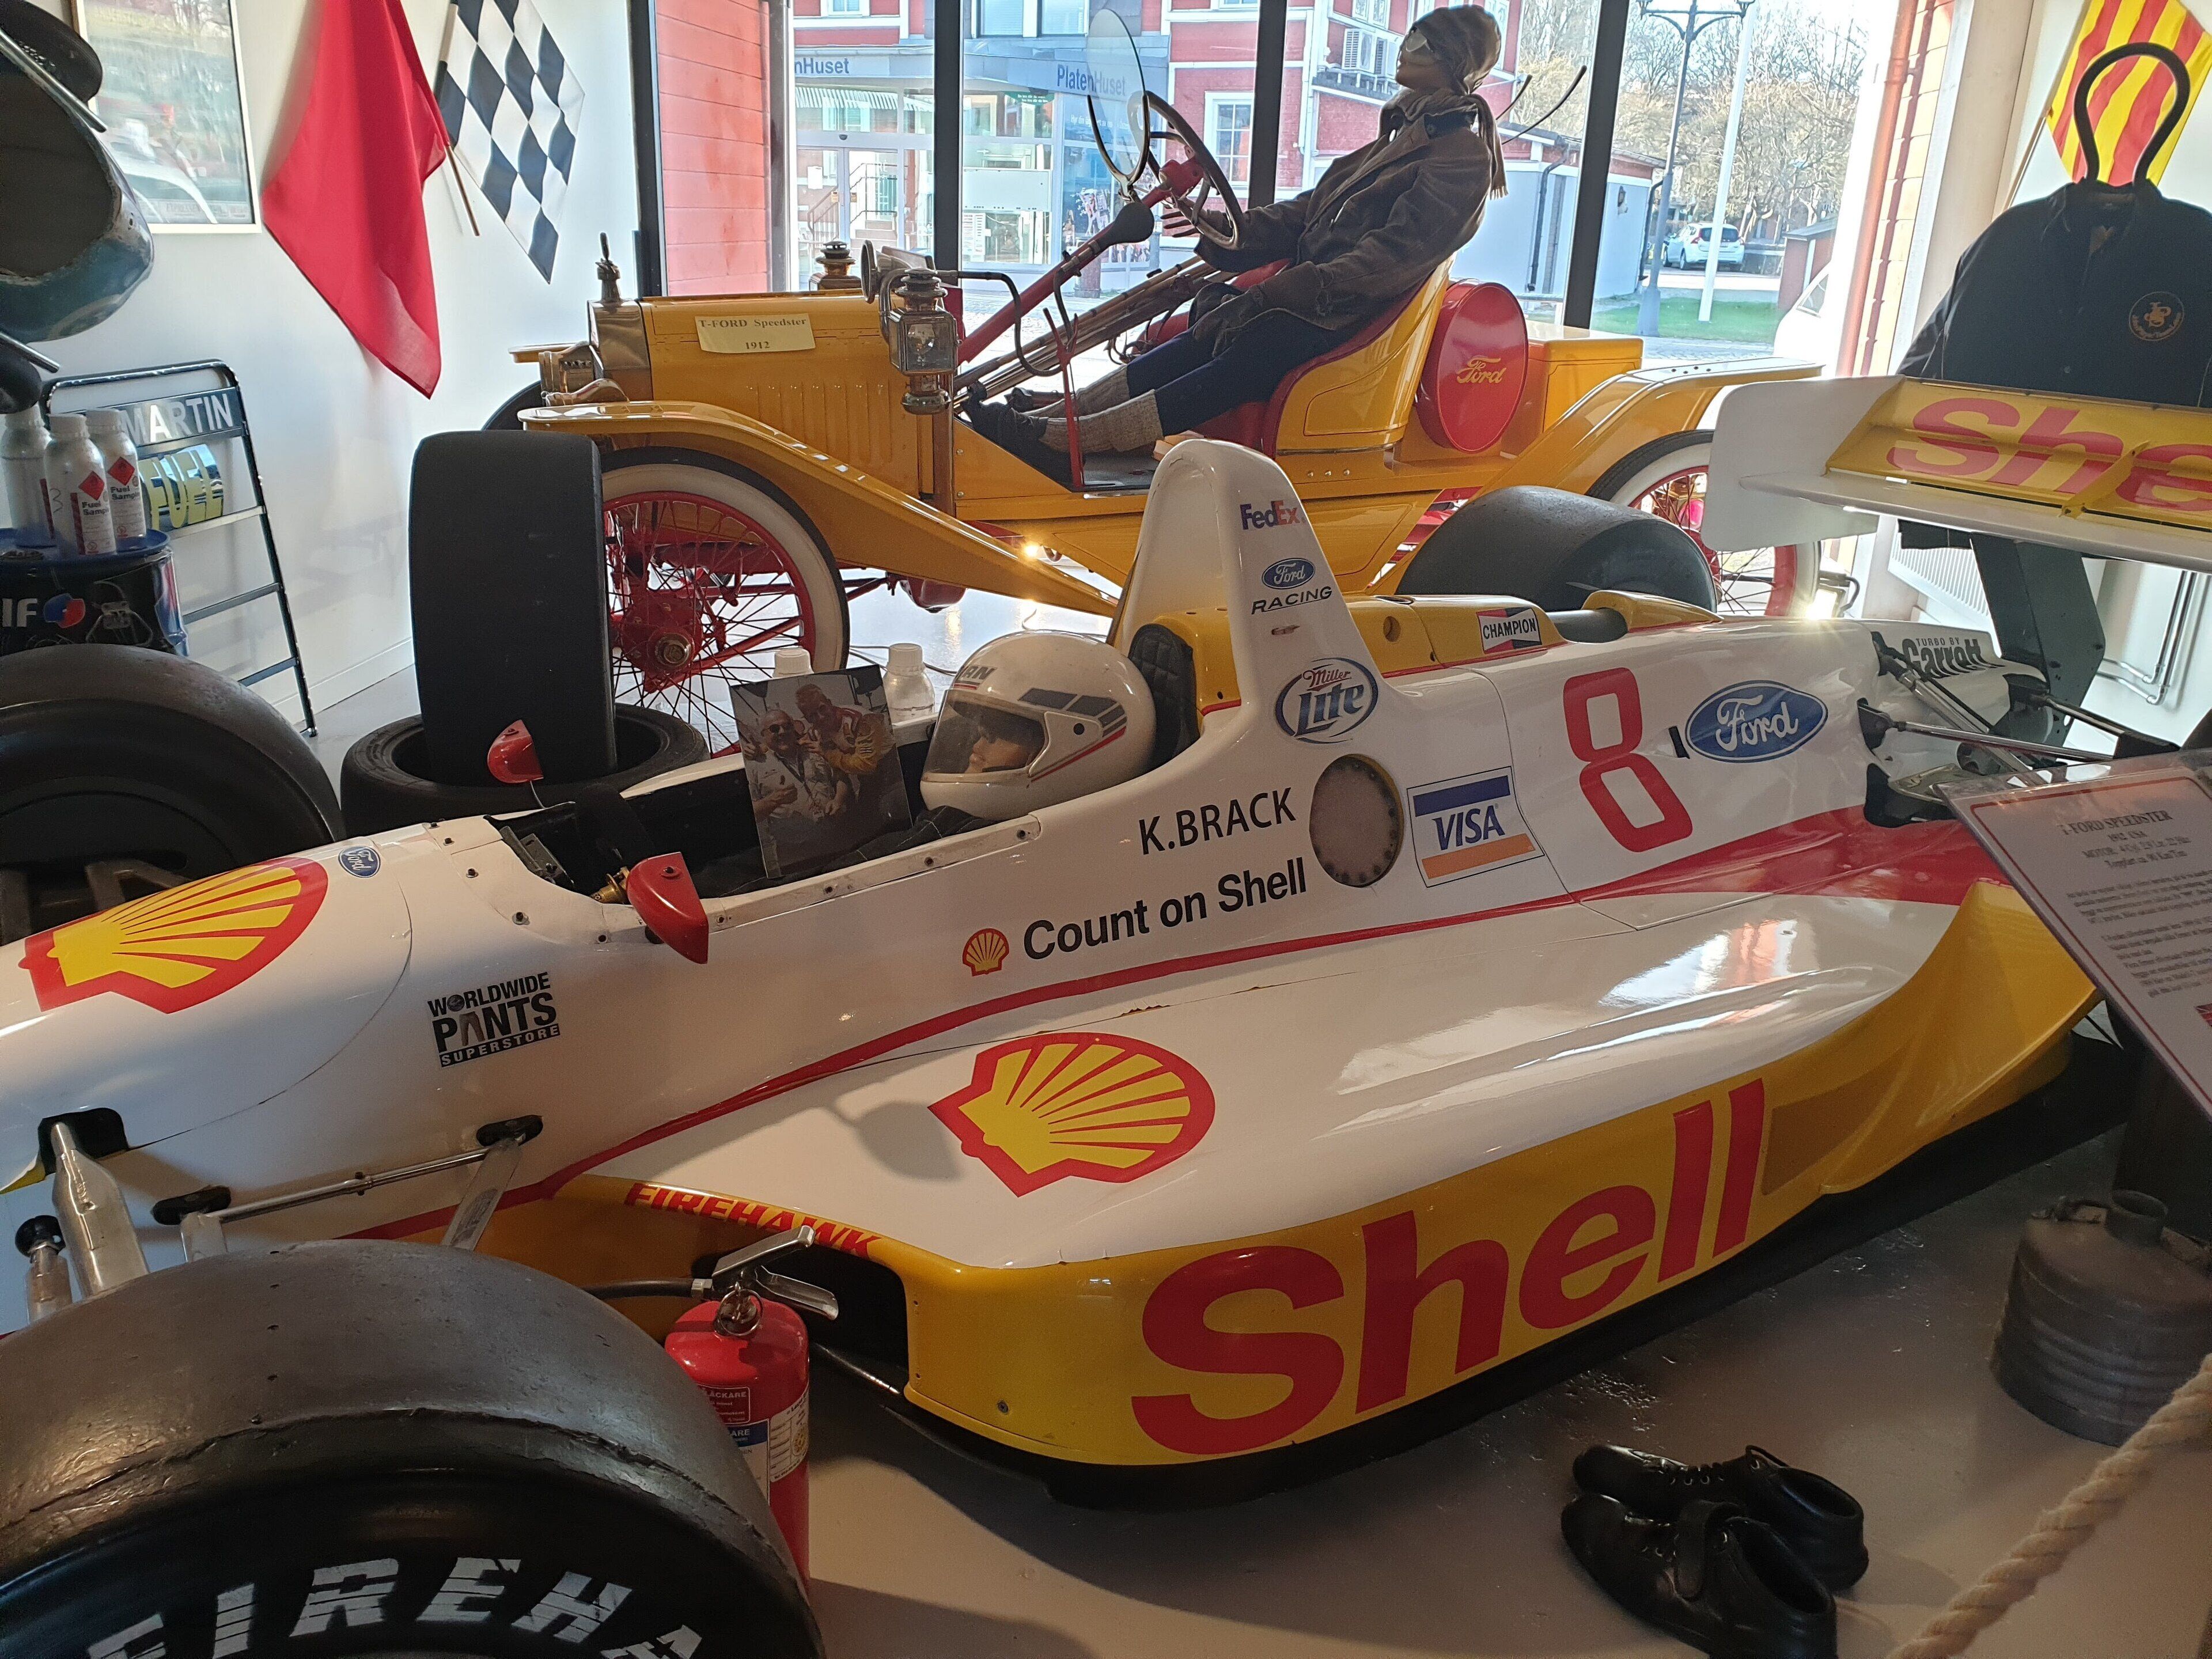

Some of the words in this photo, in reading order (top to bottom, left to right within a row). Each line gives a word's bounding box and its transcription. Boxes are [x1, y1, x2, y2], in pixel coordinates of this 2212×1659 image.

[1056, 63, 1126, 97] PlatenHuset
[699, 320, 747, 328] T-FORD
[754, 319, 806, 328] Speedster
[745, 341, 770, 349] 1912
[1457, 355, 1507, 384] Ford
[119, 393, 233, 446] MARTIN
[138, 449, 224, 530] FUEL
[1240, 500, 1301, 530] FedEx
[1274, 562, 1306, 585] Ford
[1251, 586, 1332, 615] RACING
[1482, 617, 1537, 640] CHAMPION
[1916, 638, 1945, 646] TURBO
[1949, 637, 1960, 645] BY
[1302, 669, 1351, 690] Miller
[1295, 683, 1364, 736] Lite
[1715, 694, 1798, 751] Ford
[1563, 667, 1693, 853] 8
[1138, 787, 1297, 855] K.BRACK
[1432, 804, 1505, 851] VISA
[344, 849, 374, 870] Ford
[1024, 900, 1150, 960] Count
[1160, 891, 1207, 928] on
[1218, 857, 1307, 912] Shell
[427, 971, 551, 1017] WORLDWIDE
[432, 992, 557, 1054] PANTS
[441, 1025, 559, 1065] SUPERSTORE
[624, 1183, 881, 1258] FIREHAWK
[1131, 1078, 1765, 1455] Shell
